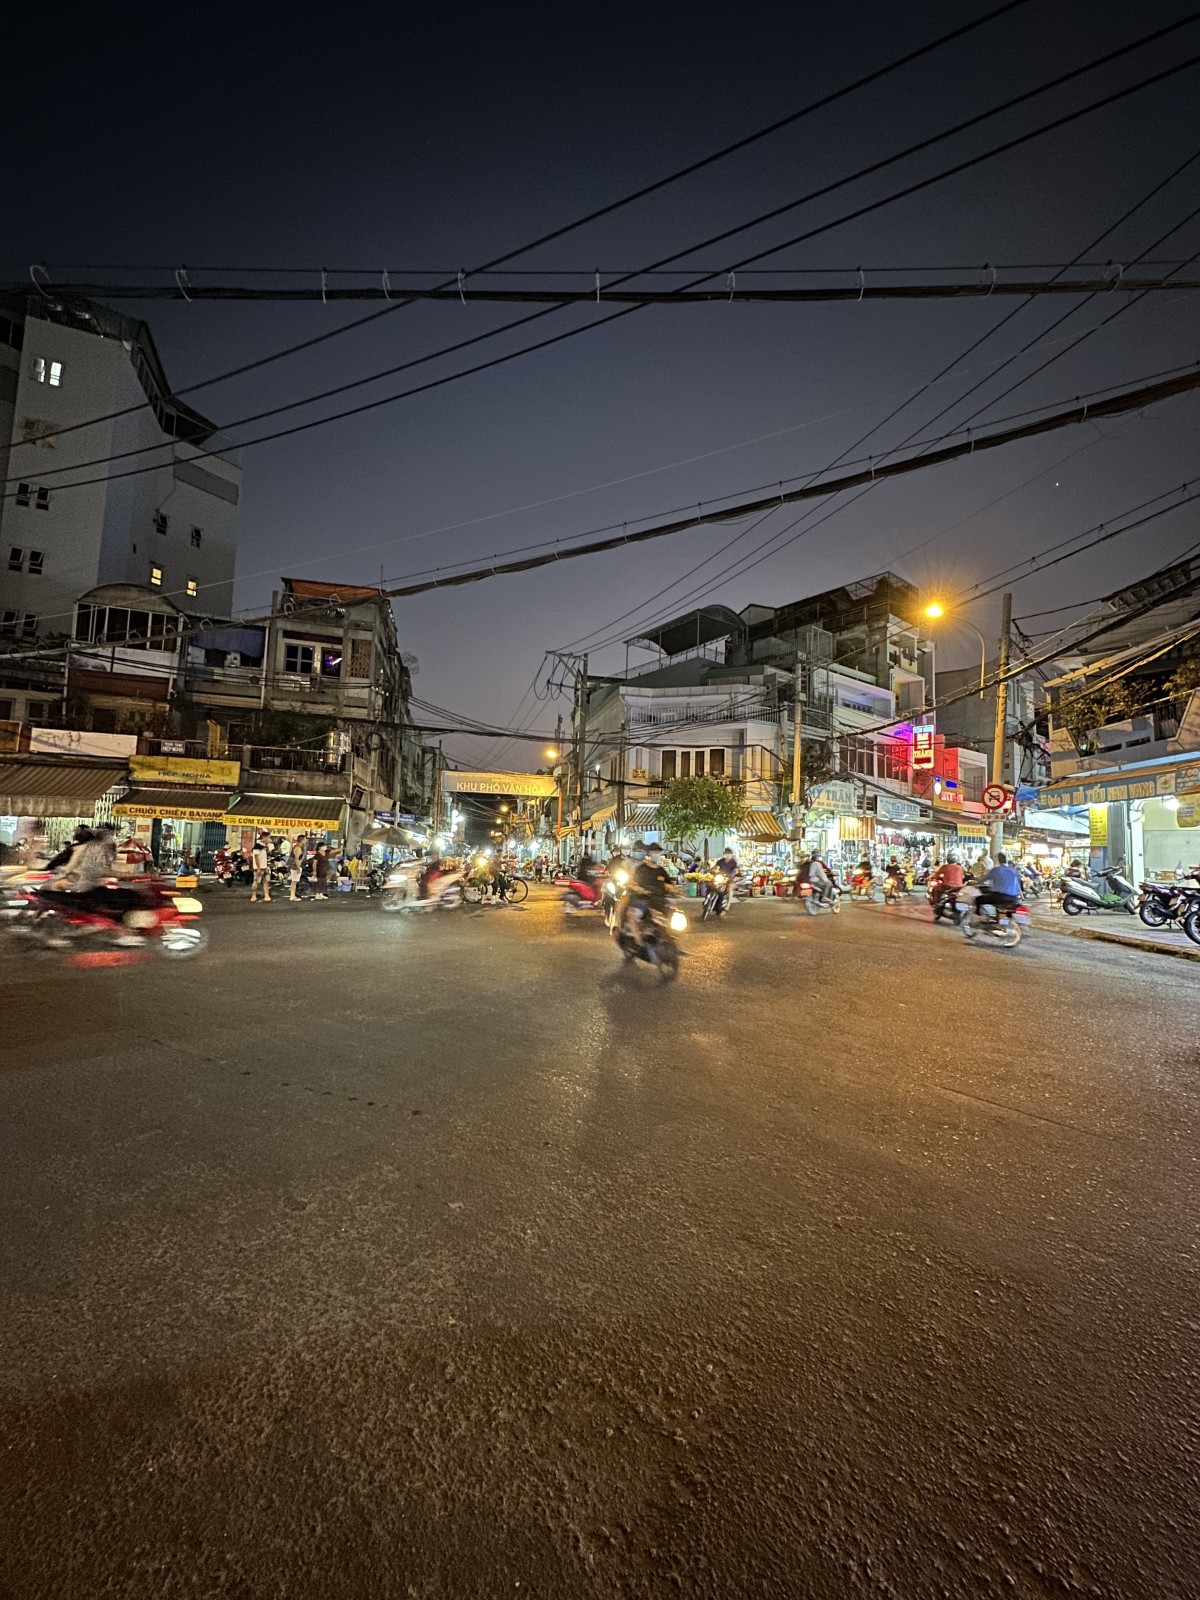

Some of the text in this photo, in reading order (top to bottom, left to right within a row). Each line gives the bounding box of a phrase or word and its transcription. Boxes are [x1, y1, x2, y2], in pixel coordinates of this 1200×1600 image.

[456, 781, 477, 791] KHU
[502, 783, 522, 793] VĂN
[1107, 785, 1128, 801] NAM
[1128, 781, 1155, 799] VANG
[238, 817, 255, 825] CƠM
[273, 818, 312, 829] PHỤNG
